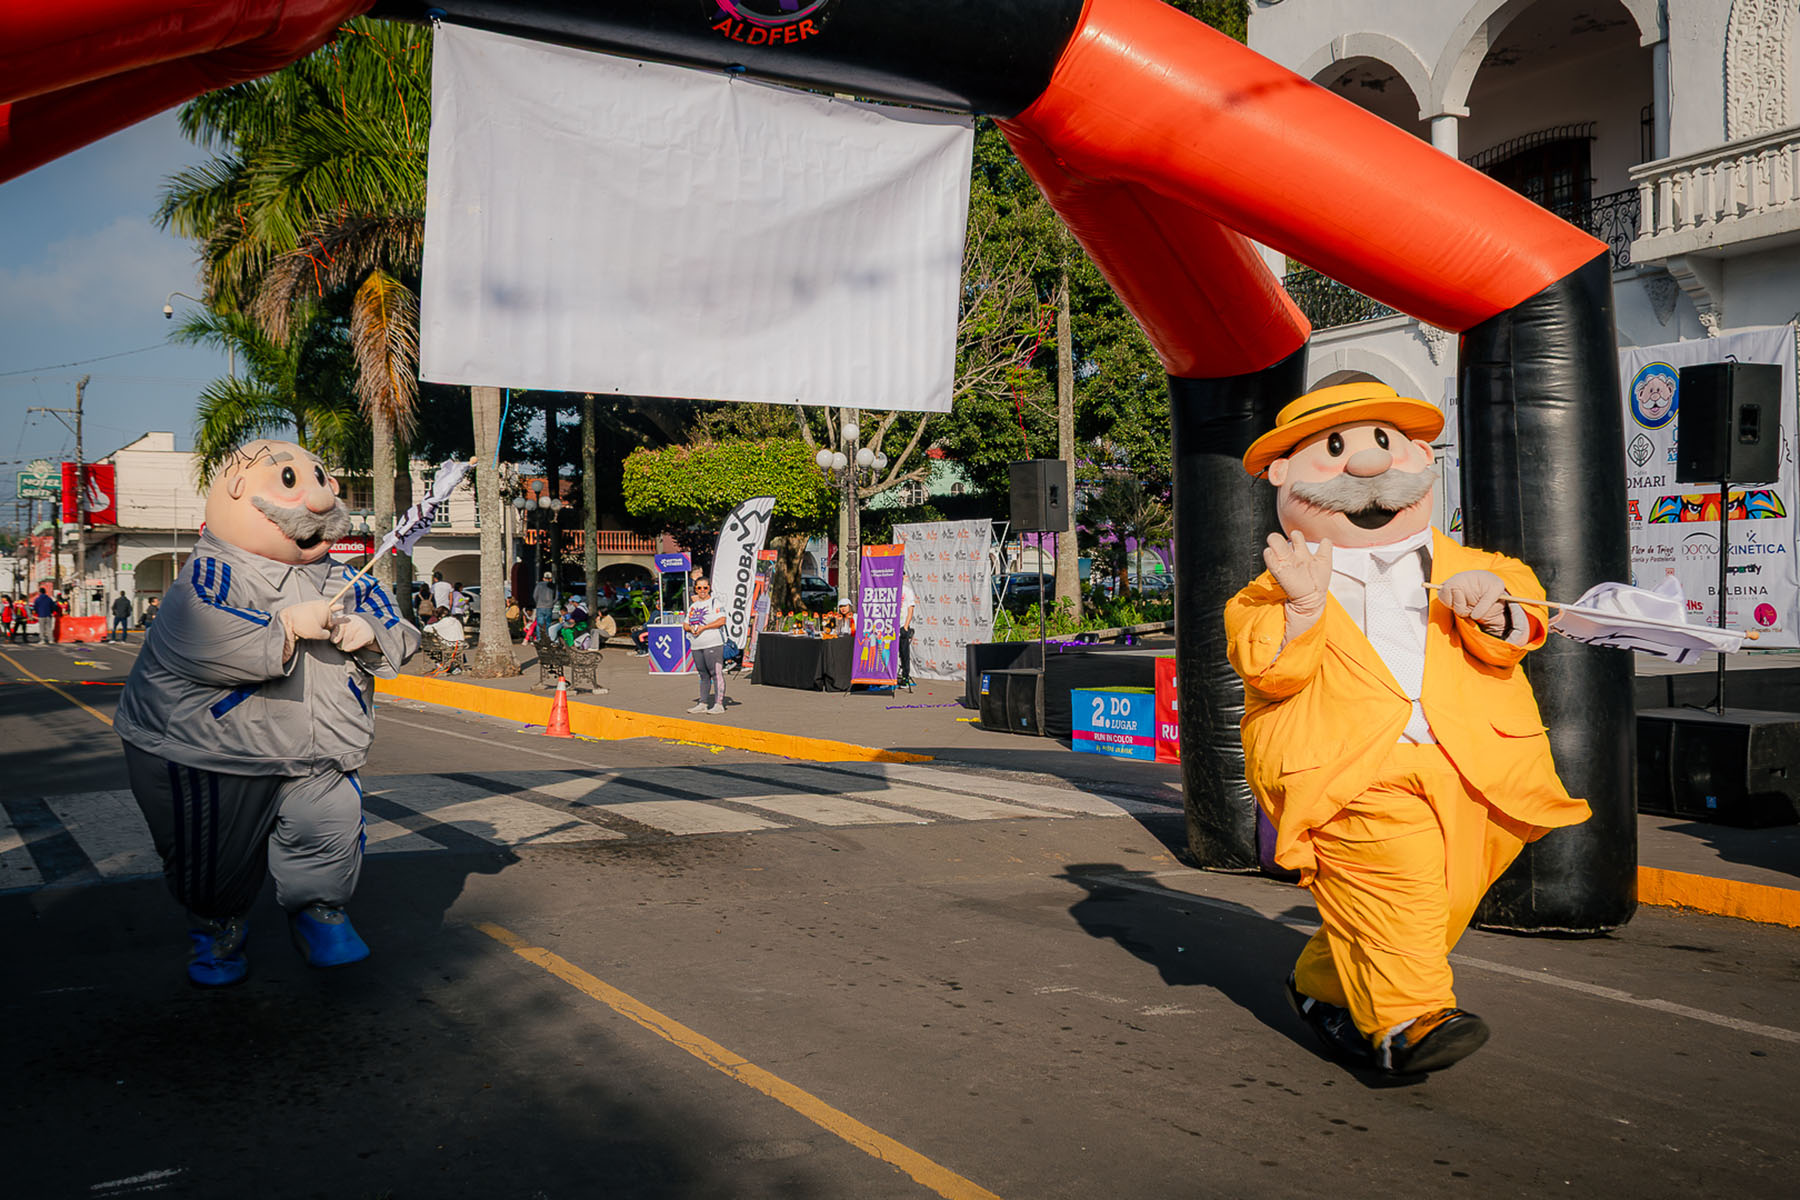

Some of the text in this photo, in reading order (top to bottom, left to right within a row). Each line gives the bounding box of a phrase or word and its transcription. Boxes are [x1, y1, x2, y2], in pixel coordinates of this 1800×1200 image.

[712, 17, 820, 46] ALDFER
[729, 542, 756, 638] CÓRDOBA
[863, 587, 898, 602] BIEN
[1708, 586, 1768, 596] BLBINA
[862, 603, 897, 618] VENI
[863, 618, 894, 635] DOS
[1110, 697, 1131, 717] DO
[1111, 719, 1137, 731] LUGAR
[1162, 724, 1178, 740] RU
[1094, 732, 1105, 741] RUN
[1112, 735, 1133, 744] COLOR
